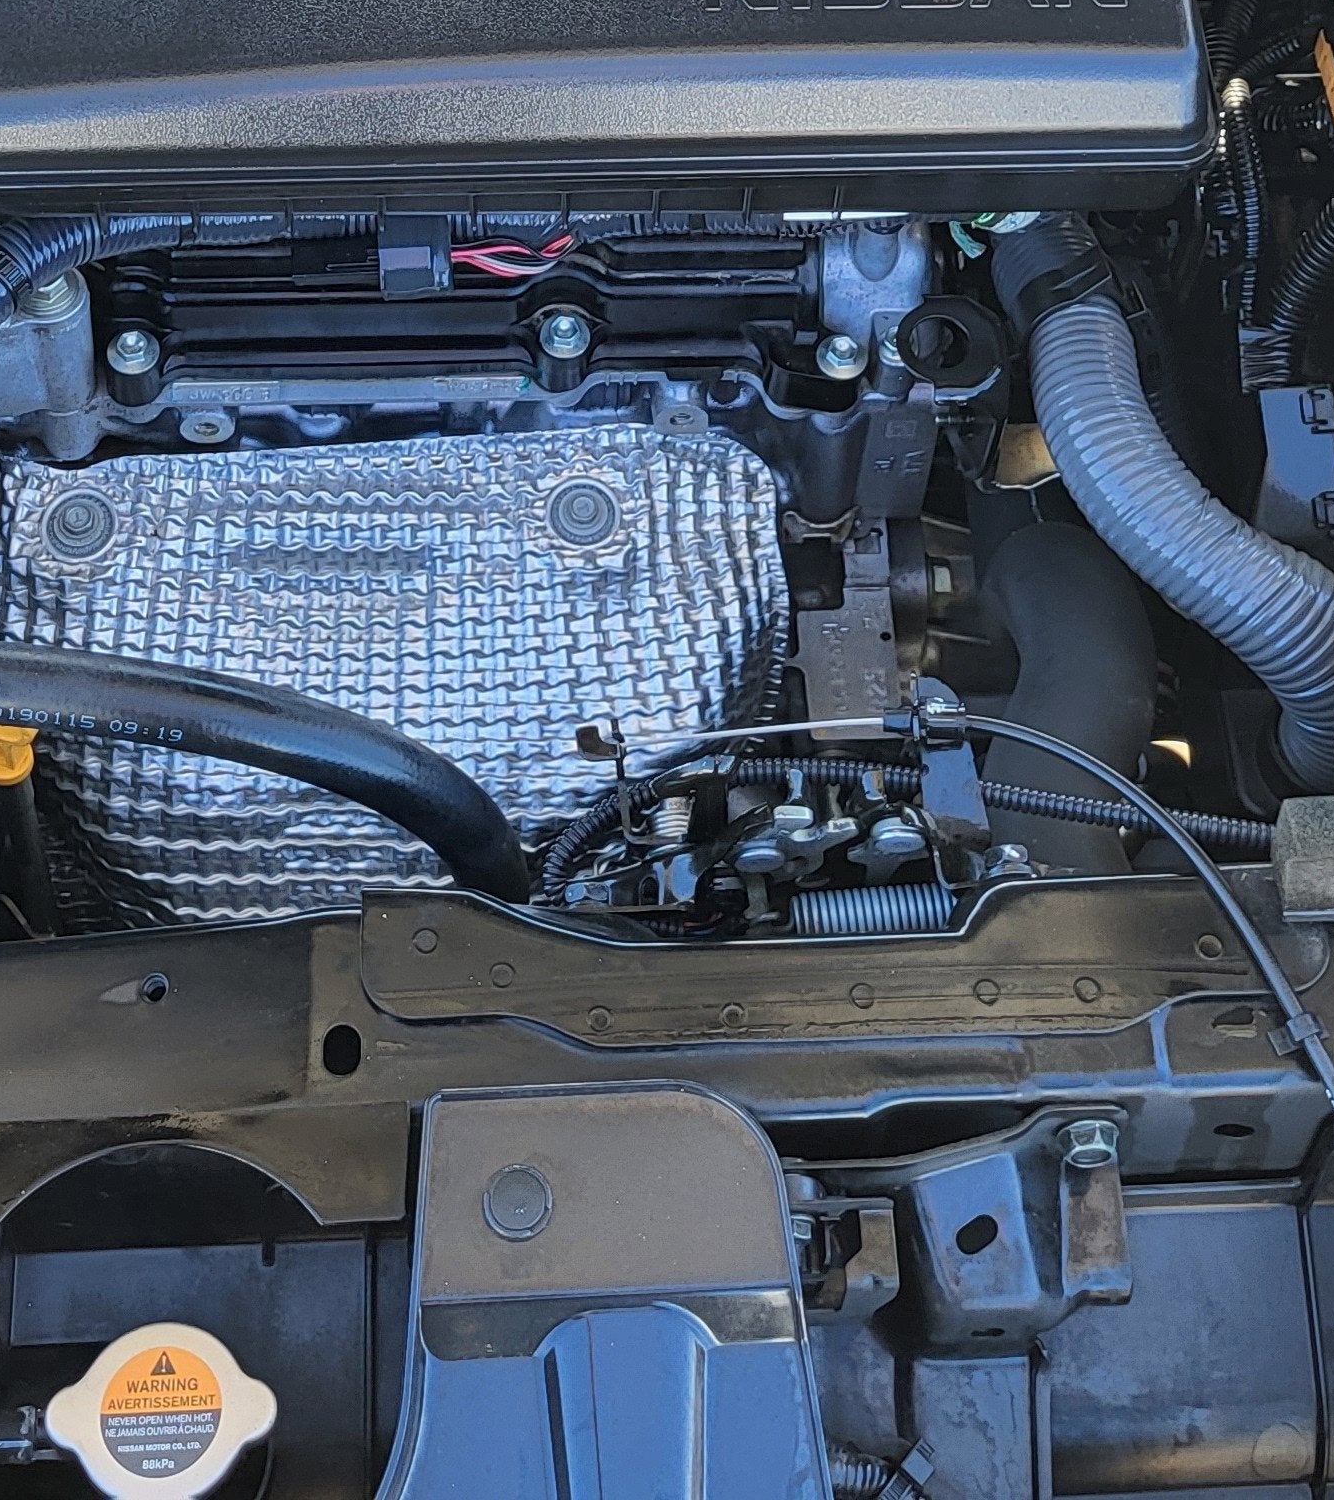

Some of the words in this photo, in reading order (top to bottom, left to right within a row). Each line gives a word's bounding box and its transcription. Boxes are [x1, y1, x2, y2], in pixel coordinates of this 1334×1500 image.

[109, 719, 184, 743] 09:19
[126, 1377, 198, 1393] WARNING
[107, 1394, 216, 1410] AVERTISSEMENT
[108, 1416, 137, 1426] NEVER
[138, 1415, 164, 1425] OPEN
[164, 1414, 192, 1424] WHEN
[193, 1412, 214, 1423] HOT.
[105, 1428, 117, 1438] NE
[117, 1427, 146, 1437] JAMAIS
[146, 1425, 178, 1436] OUVRIR
[117, 1444, 144, 1453] NISSAN
[145, 1443, 171, 1452] MOTOR
[187, 1442, 202, 1450] LTD.
[142, 1458, 175, 1470] 88kPa
